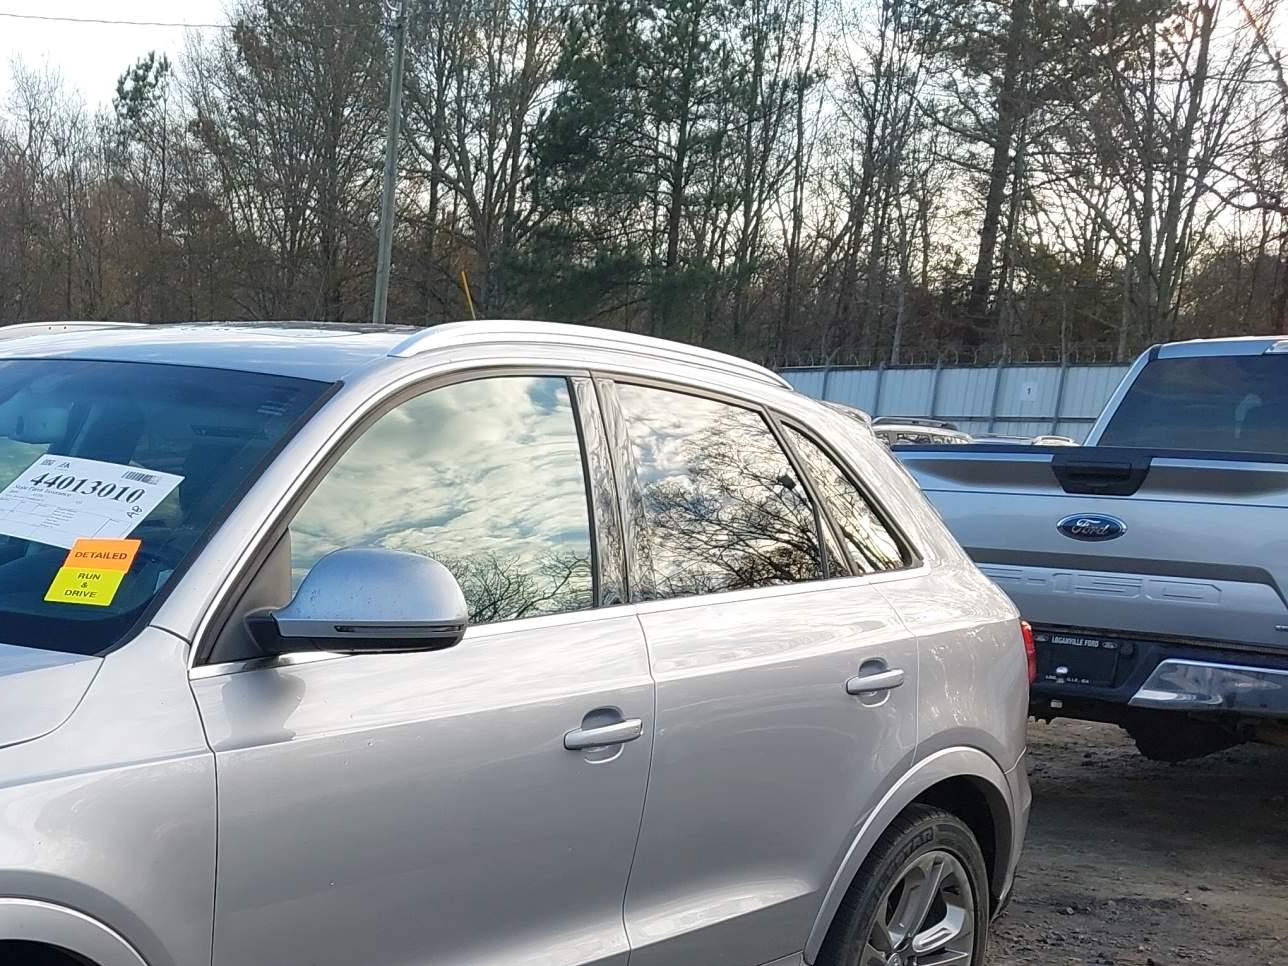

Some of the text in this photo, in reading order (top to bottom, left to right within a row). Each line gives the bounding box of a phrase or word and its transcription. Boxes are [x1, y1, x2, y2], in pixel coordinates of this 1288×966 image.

[31, 472, 145, 504] 44013010
[1072, 519, 1110, 534] Ford
[75, 551, 127, 560] DETAILED
[78, 572, 101, 580] RUN
[64, 590, 97, 598] DRIVE
[1084, 639, 1099, 647] FORD
